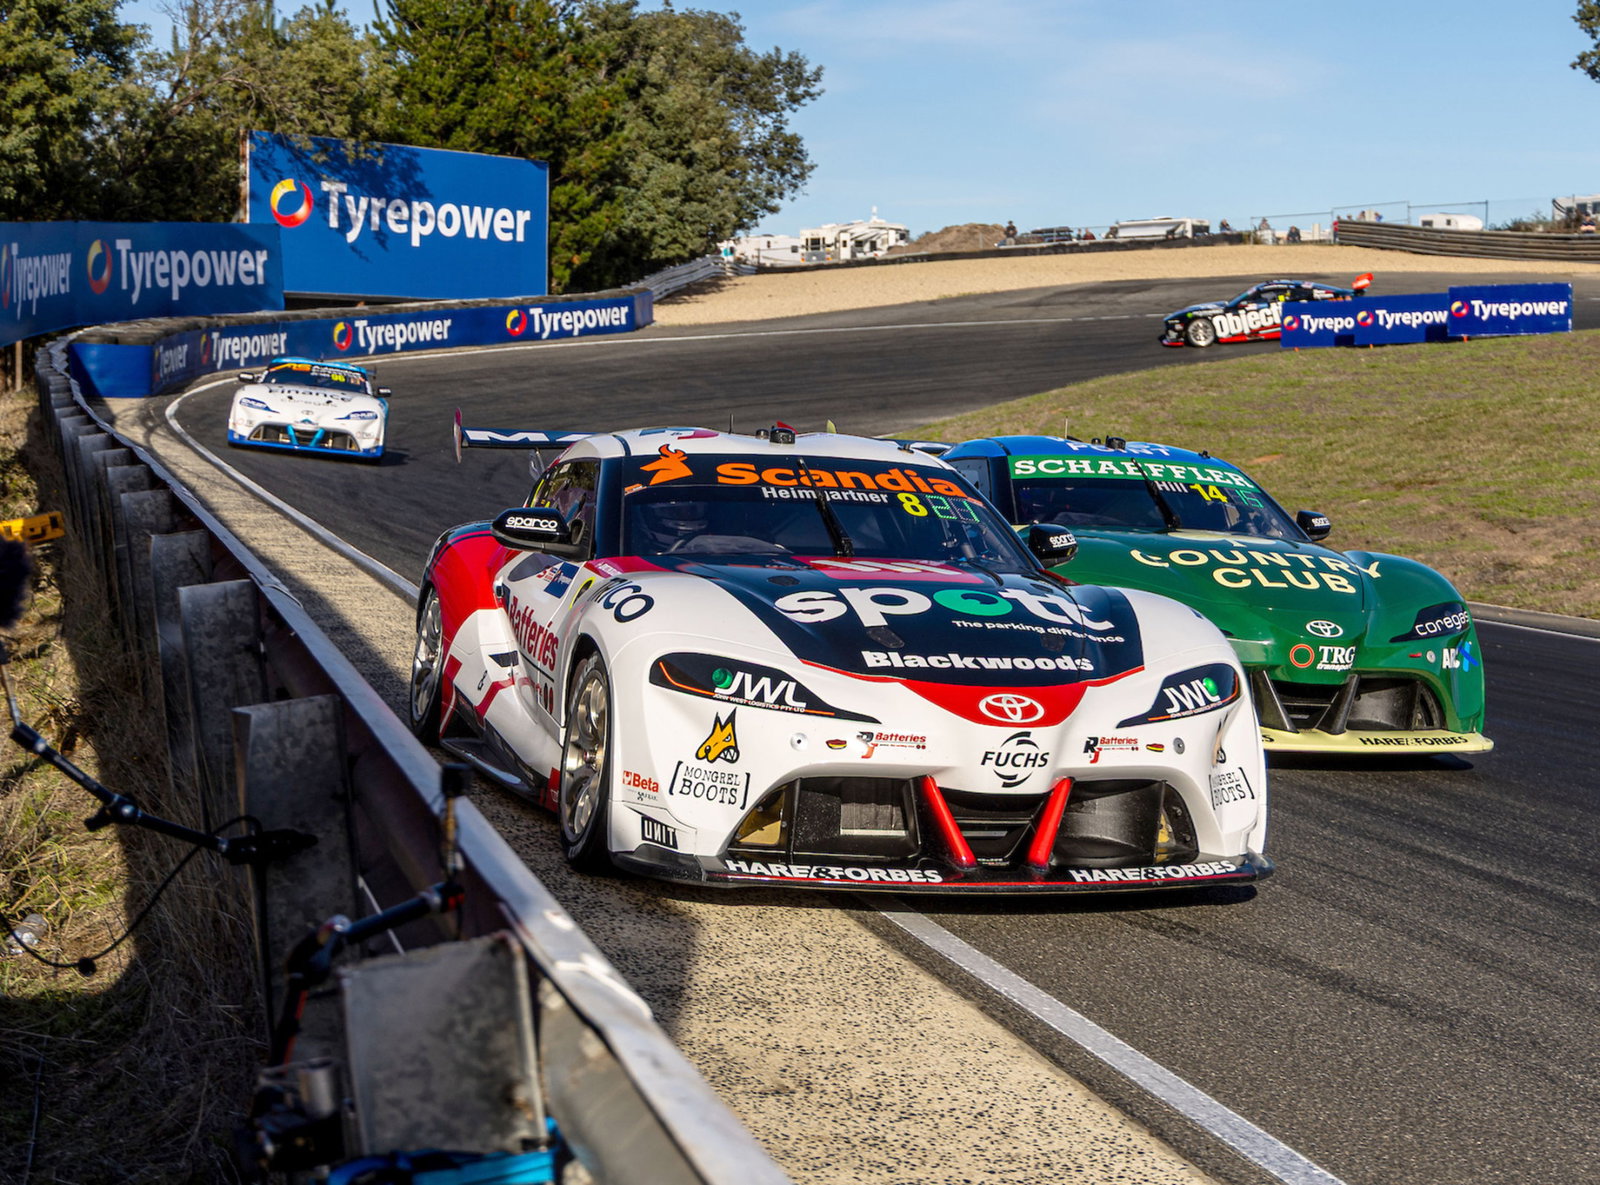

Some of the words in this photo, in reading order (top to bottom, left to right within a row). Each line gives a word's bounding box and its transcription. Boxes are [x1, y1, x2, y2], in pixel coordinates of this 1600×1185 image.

[320, 180, 531, 247] Tyrepower
[11, 242, 72, 320] Tyrepower
[115, 239, 268, 305] Tyrepower
[529, 306, 629, 339] Tyrepower
[1470, 300, 1568, 321] Tyrepower
[354, 319, 452, 354] Tyrepower
[211, 331, 288, 370] Tyrepower
[716, 462, 968, 497] Scandia
[1014, 459, 1255, 489] SCHAEFFLER
[1156, 479, 1189, 494] Hill
[1190, 483, 1228, 503] 14
[897, 492, 929, 517] 8
[506, 516, 558, 530] sparco
[1131, 549, 1382, 579] COUNTRY
[1211, 567, 1357, 594] CLUB
[509, 596, 559, 672] Batteries
[951, 620, 983, 628] The
[984, 622, 1044, 634] parking
[1046, 627, 1125, 643] difference
[1415, 611, 1469, 636] coregas
[861, 650, 1095, 672] Blackwoods
[1319, 645, 1356, 664] TRG
[714, 671, 807, 708] JWL
[1163, 679, 1220, 714] JWL
[875, 732, 927, 743] Batteries
[1099, 736, 1138, 745] Batteries
[980, 751, 1050, 768] FUCHS
[632, 773, 659, 793] Beta
[684, 766, 741, 787] MONGREL
[679, 778, 738, 805] BOOTS
[644, 819, 676, 846] UNIT
[724, 859, 944, 883] HARE&FORBES
[1069, 860, 1238, 882] HARE&FORBES
